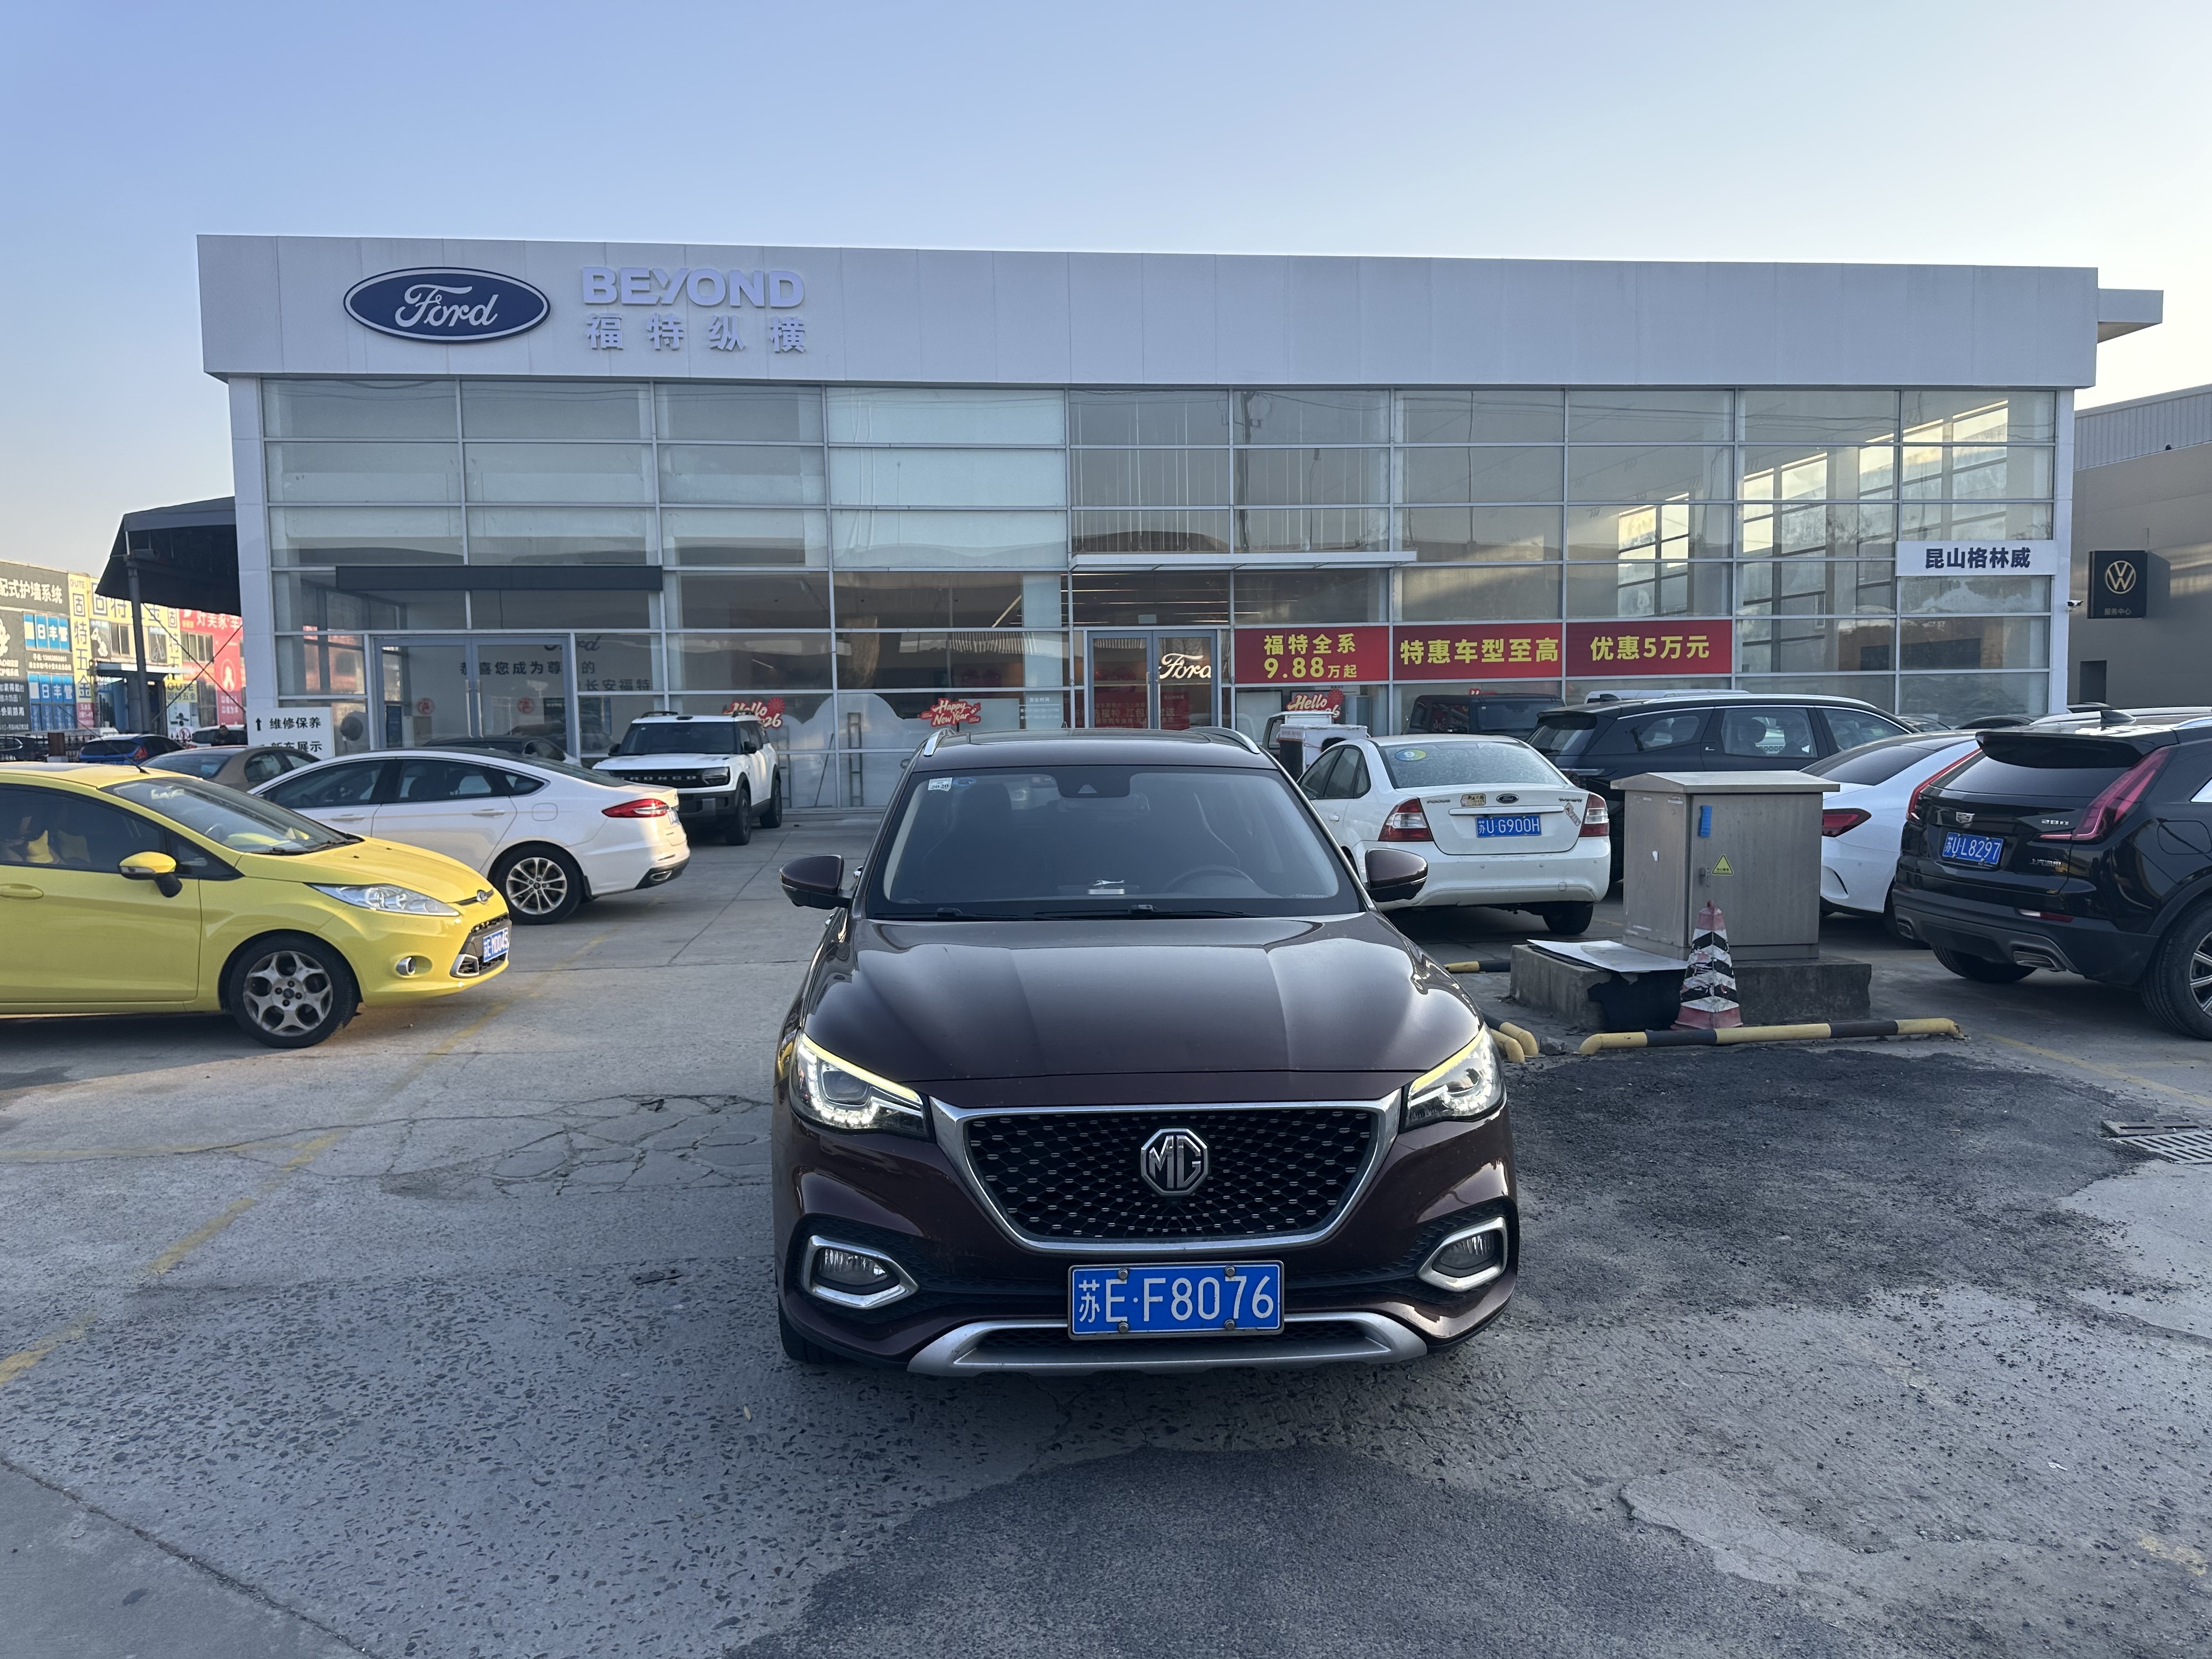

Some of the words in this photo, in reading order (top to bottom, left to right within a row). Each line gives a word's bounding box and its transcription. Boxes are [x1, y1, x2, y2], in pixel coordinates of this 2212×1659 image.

[583, 267, 805, 308] BEYOND
[394, 283, 498, 328] Ford
[585, 313, 806, 353] 福特纵横
[1925, 547, 2031, 569] 昆山格林威
[70, 579, 86, 589] GUTE
[72, 592, 92, 698] 固特五金
[1263, 633, 1356, 656] 福特全系
[1400, 637, 1559, 665] 特惠车型至高
[1590, 635, 1710, 661] 优惠5万元
[1263, 657, 1358, 679] 9.88万起
[167, 682, 194, 691] GUTE
[932, 699, 971, 714] Happy
[1288, 694, 1328, 711] Hello
[269, 716, 321, 730] 维修保养
[932, 713, 952, 726] New
[952, 711, 970, 724] Year
[1478, 817, 1540, 834] 苏U·G900H
[1944, 836, 2001, 860] 苏U·L8297
[1149, 1135, 1201, 1189] MG
[1079, 1275, 1274, 1323] 苏E·F8076
